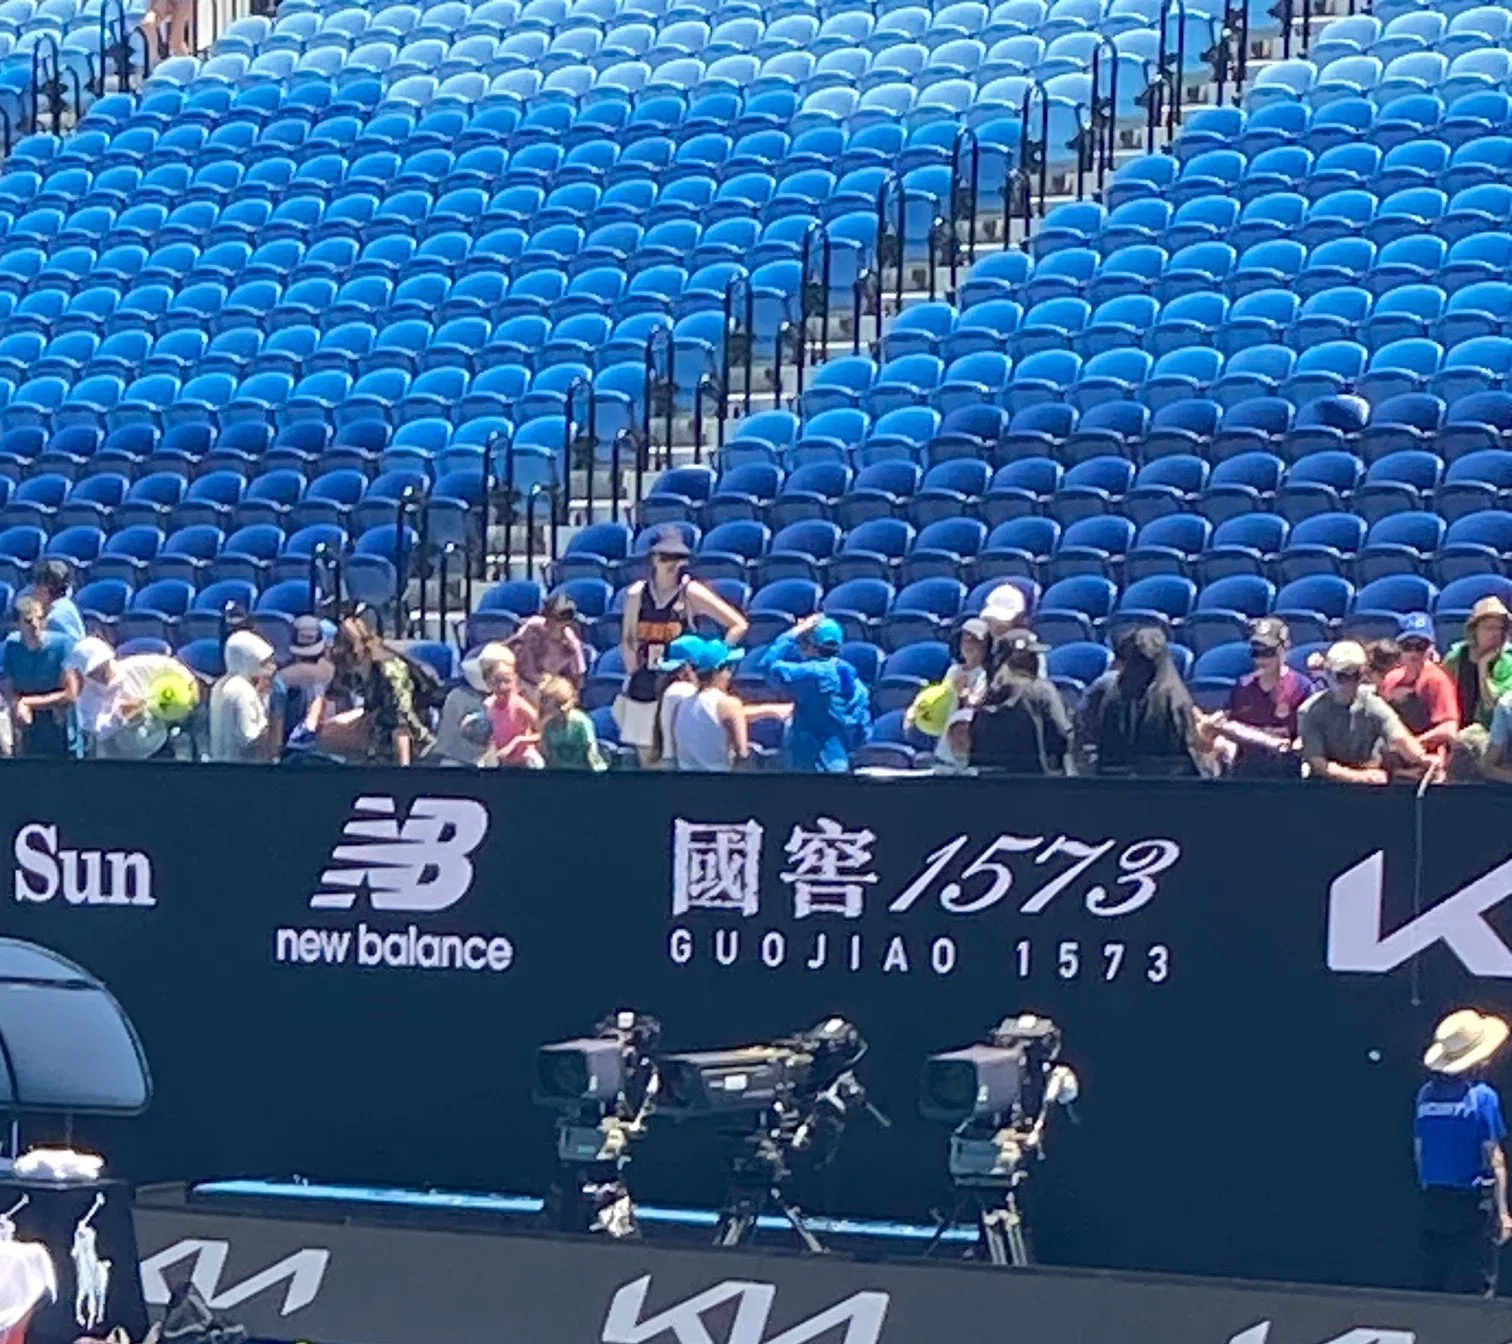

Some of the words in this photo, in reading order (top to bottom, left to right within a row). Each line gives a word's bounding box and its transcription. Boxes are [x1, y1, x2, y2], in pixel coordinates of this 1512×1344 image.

[14, 822, 157, 906] Sun
[310, 796, 489, 910] NB
[276, 927, 352, 963] new
[357, 922, 514, 971] balance
[670, 928, 957, 974] GUOJIAO
[1016, 940, 1171, 983] 1573
